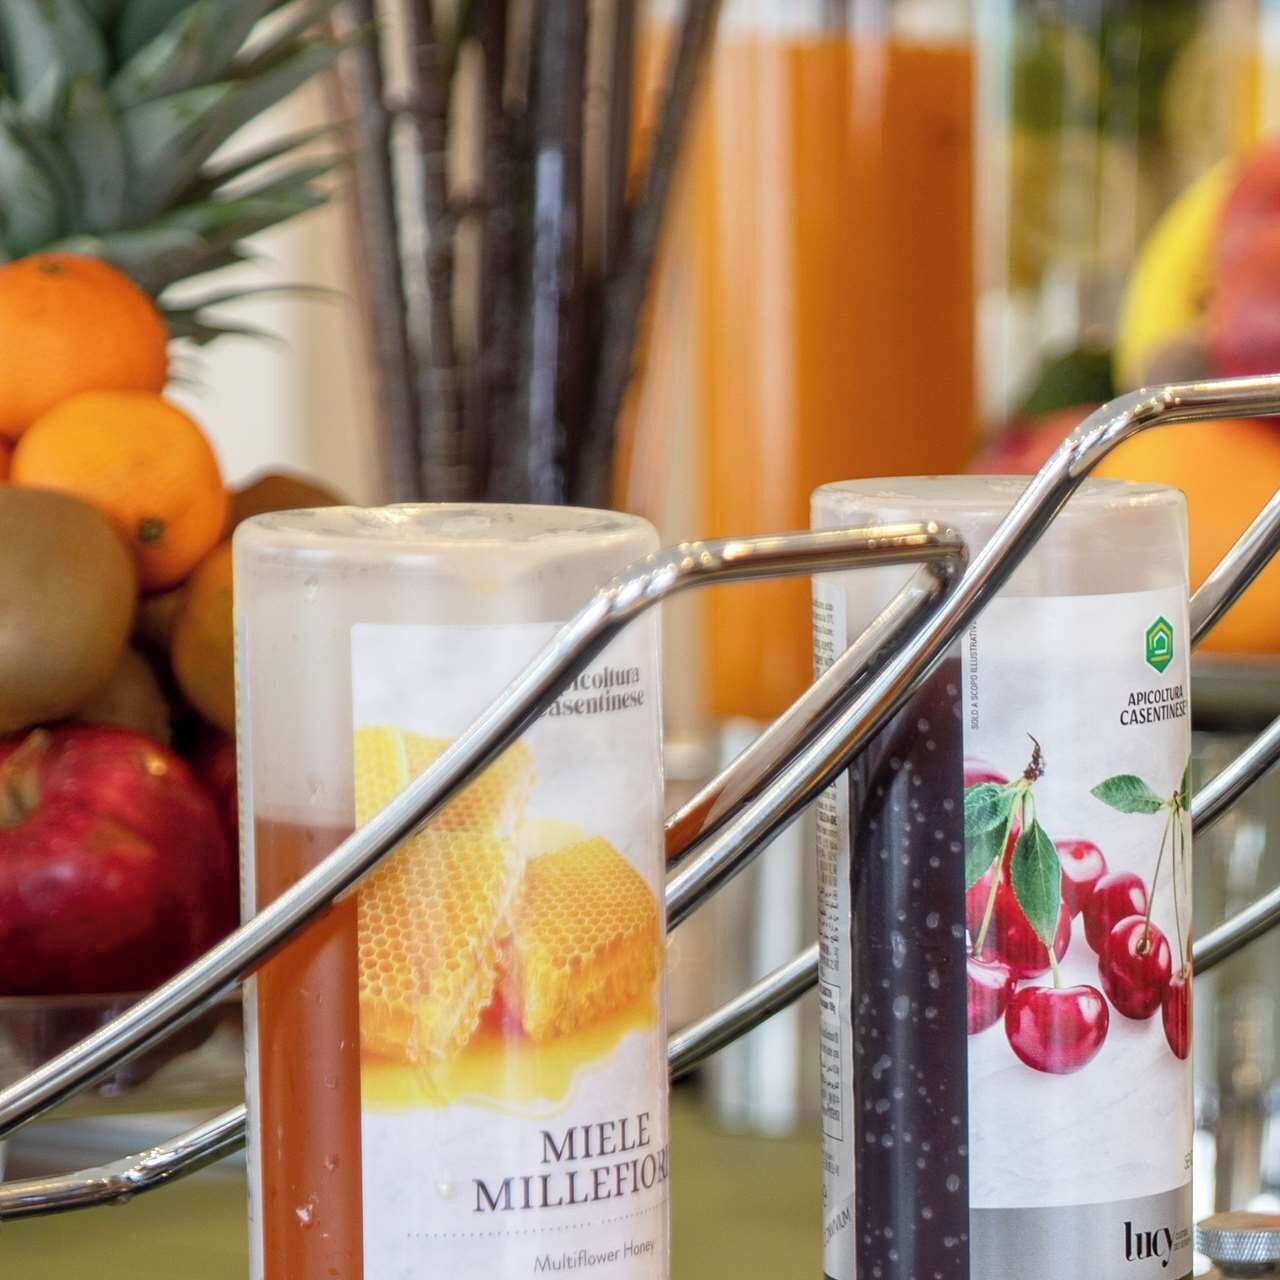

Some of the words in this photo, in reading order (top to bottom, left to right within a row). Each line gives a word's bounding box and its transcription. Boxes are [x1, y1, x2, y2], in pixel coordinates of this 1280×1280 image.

[539, 689, 645, 718] asentinese
[1128, 685, 1183, 707] APICOLTURA
[540, 1111, 651, 1164] MIELE
[533, 1247, 620, 1273] Multiflower
[622, 1239, 656, 1260] Honey
[1123, 1220, 1173, 1268] lucy
